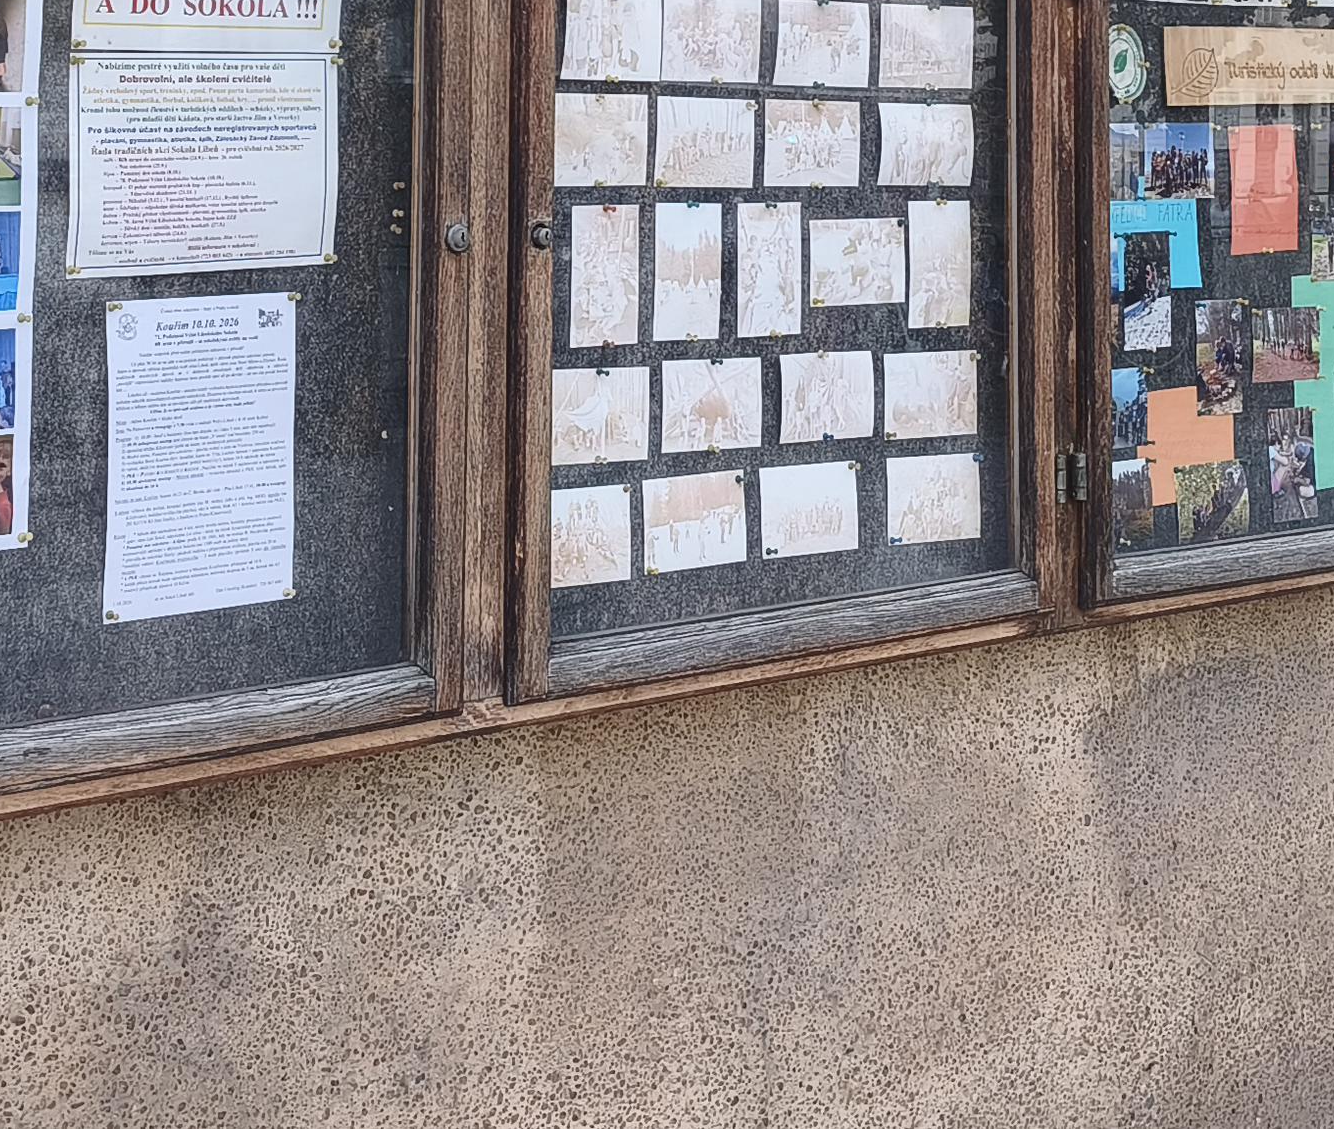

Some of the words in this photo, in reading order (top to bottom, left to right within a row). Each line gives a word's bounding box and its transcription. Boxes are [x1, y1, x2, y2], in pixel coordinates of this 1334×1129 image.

[96, 62, 136, 72] Nabízíme
[192, 63, 221, 71] volného
[119, 75, 176, 85] Dobrovolní,
[179, 75, 193, 83] ale
[195, 75, 229, 83] školení
[232, 75, 271, 83] cvičitelé
